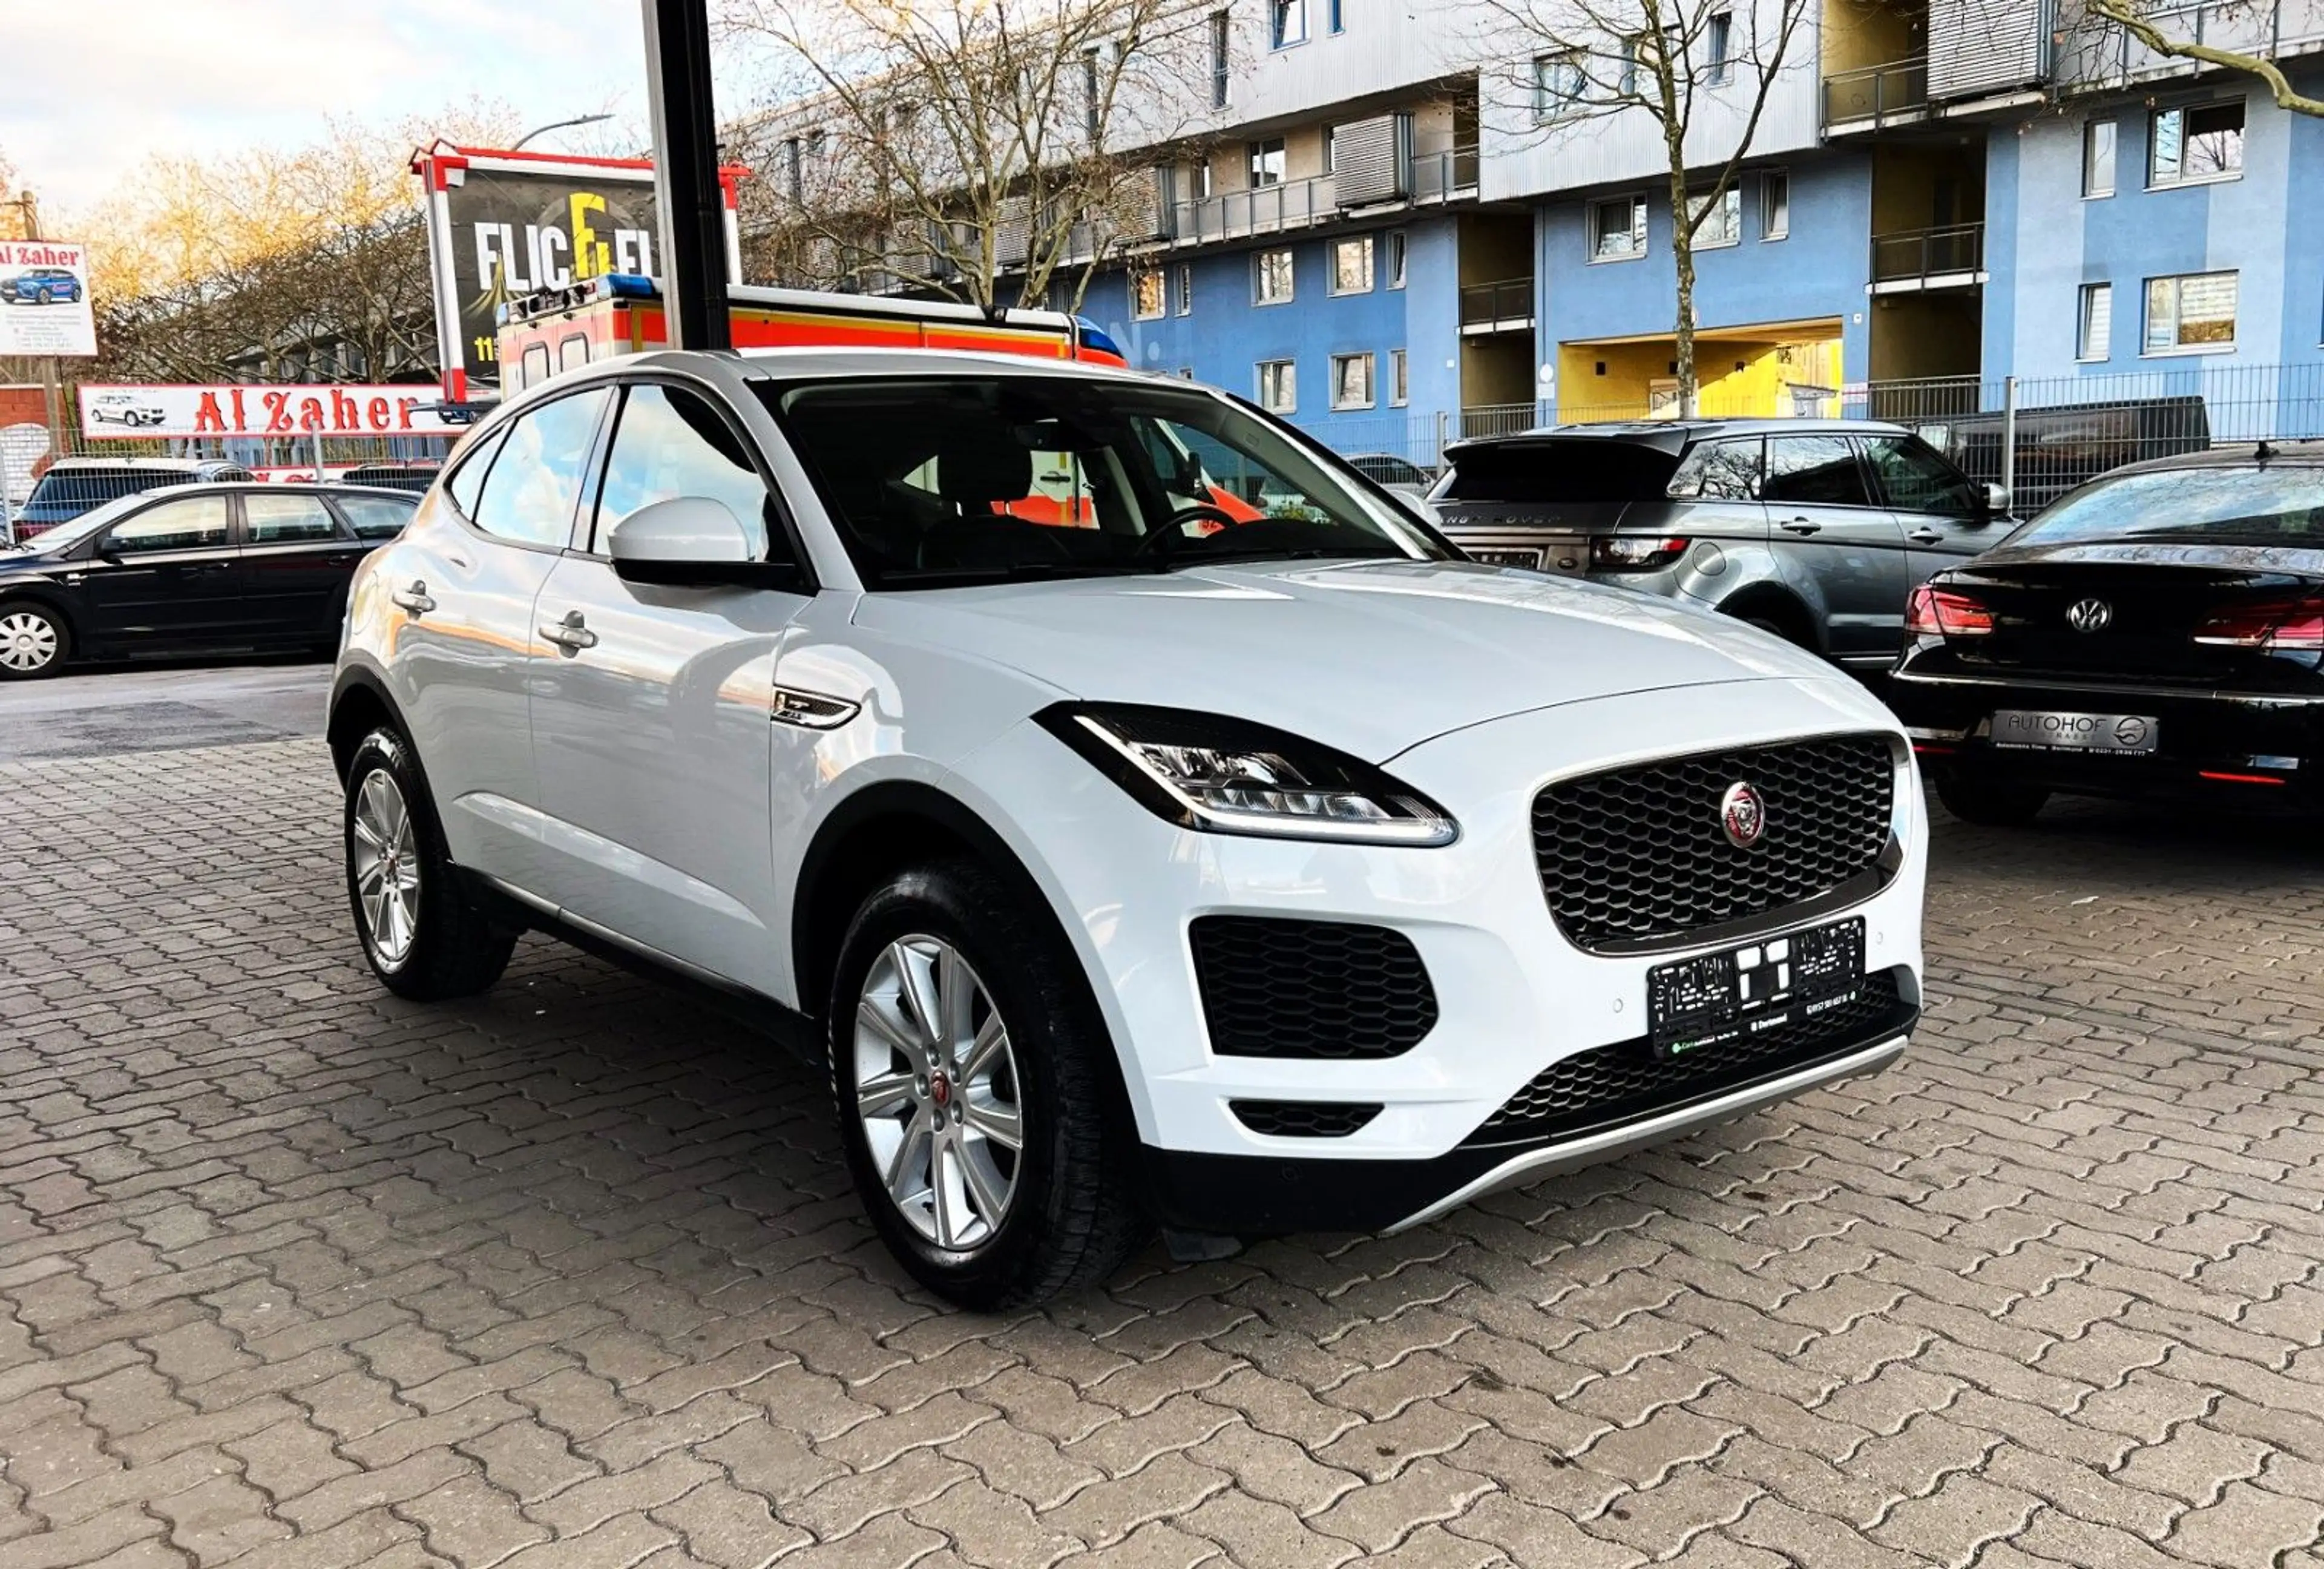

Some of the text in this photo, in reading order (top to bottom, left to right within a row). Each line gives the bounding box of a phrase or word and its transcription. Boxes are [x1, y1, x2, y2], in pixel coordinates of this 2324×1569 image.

[17, 246, 79, 266] Zaher
[194, 389, 419, 432] Al Zaher
[2008, 714, 2107, 732] AUTOHOF
